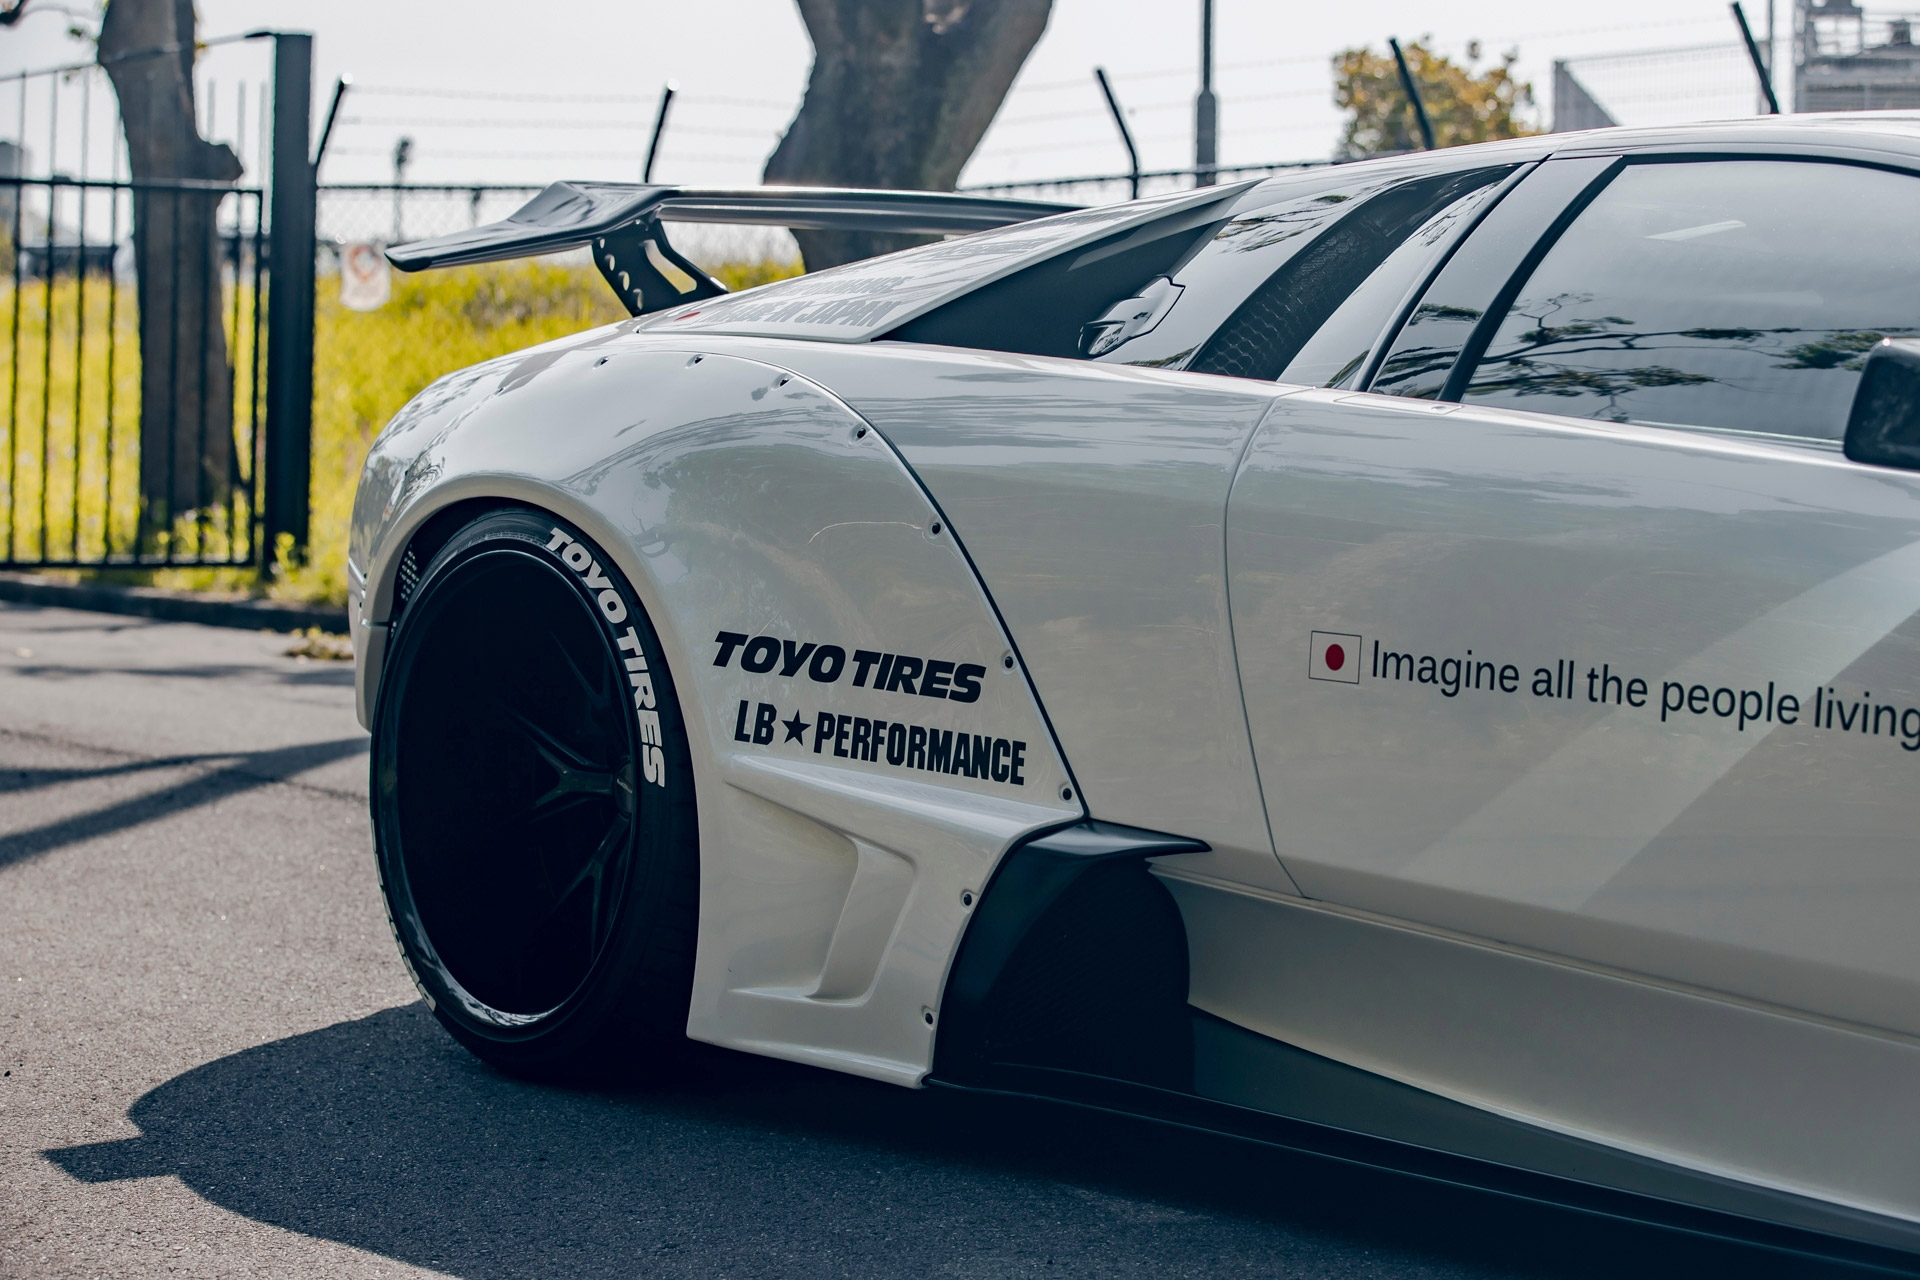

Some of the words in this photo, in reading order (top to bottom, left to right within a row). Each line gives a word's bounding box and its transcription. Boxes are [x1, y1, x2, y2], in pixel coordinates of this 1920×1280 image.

[764, 301, 809, 323] IN
[794, 300, 901, 328] JAPAN
[545, 526, 628, 624] TOYO
[616, 626, 665, 788] TIRES
[712, 630, 846, 684] TOYO
[852, 649, 987, 704] TIRES
[1371, 640, 1520, 697] Imagine
[1531, 659, 1576, 700] all
[1587, 664, 1648, 708] the
[1660, 681, 1800, 731] people
[1814, 686, 1920, 752] living
[734, 699, 778, 746] LB
[813, 711, 1027, 786] PERFORMANCE
